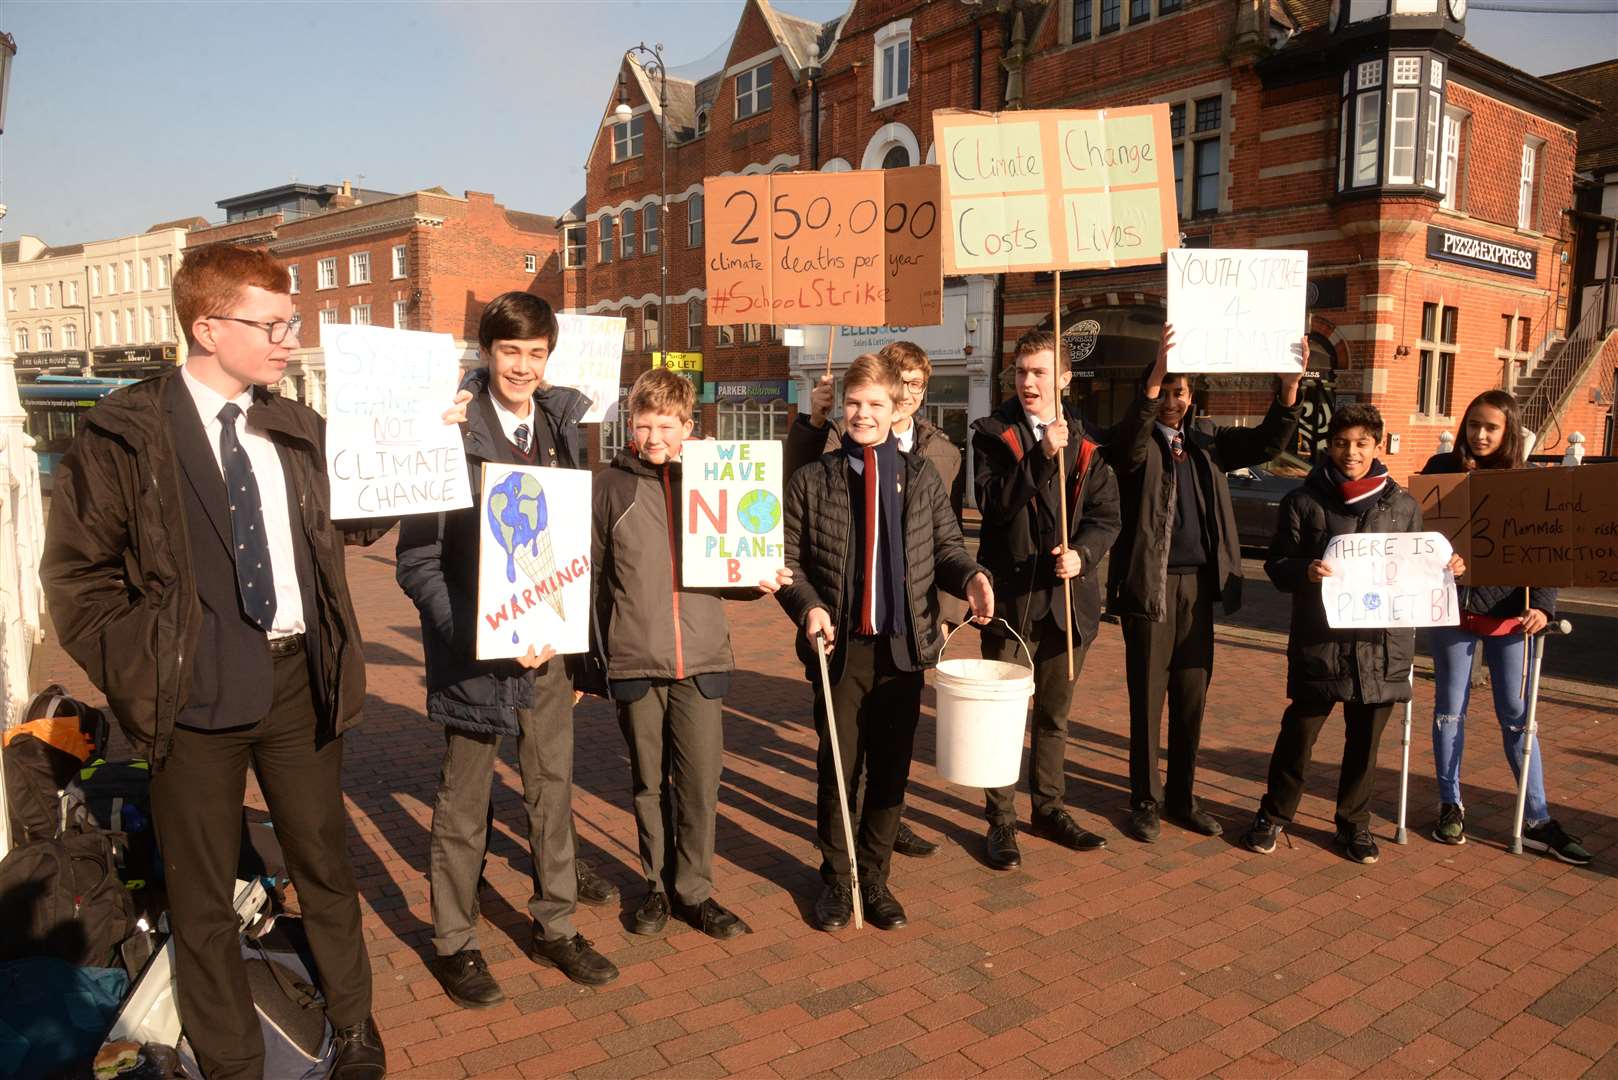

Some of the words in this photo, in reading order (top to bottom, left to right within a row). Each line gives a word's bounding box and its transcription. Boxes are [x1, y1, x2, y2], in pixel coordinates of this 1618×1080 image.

[952, 136, 1040, 181] Climate
[1064, 128, 1154, 174] Change
[723, 190, 937, 246] 250,000
[959, 207, 1038, 256] Costs
[1072, 200, 1143, 252] Lives
[710, 252, 764, 271] climate
[780, 246, 845, 273] deaths
[853, 253, 880, 279] per
[888, 252, 925, 277] year
[1443, 233, 1532, 270] PIZZAEXPRESS
[1171, 252, 1242, 289] YOUTH
[1247, 257, 1305, 290] STRIKE
[1223, 295, 1251, 328] 4
[677, 360, 696, 368] LET
[718, 385, 747, 396] PARKER
[373, 416, 416, 441] NOT
[333, 447, 459, 480] CLIMATE
[717, 443, 751, 461] WE
[704, 462, 766, 482] HAVE
[358, 478, 457, 513] CHANGE
[1545, 488, 1591, 513] Land
[705, 535, 784, 558] PLANET
[1329, 537, 1398, 560] THERE
[1411, 537, 1436, 556] IS
[727, 559, 742, 583] B
[485, 555, 592, 631] WARMING!
[1430, 588, 1451, 622] B!
